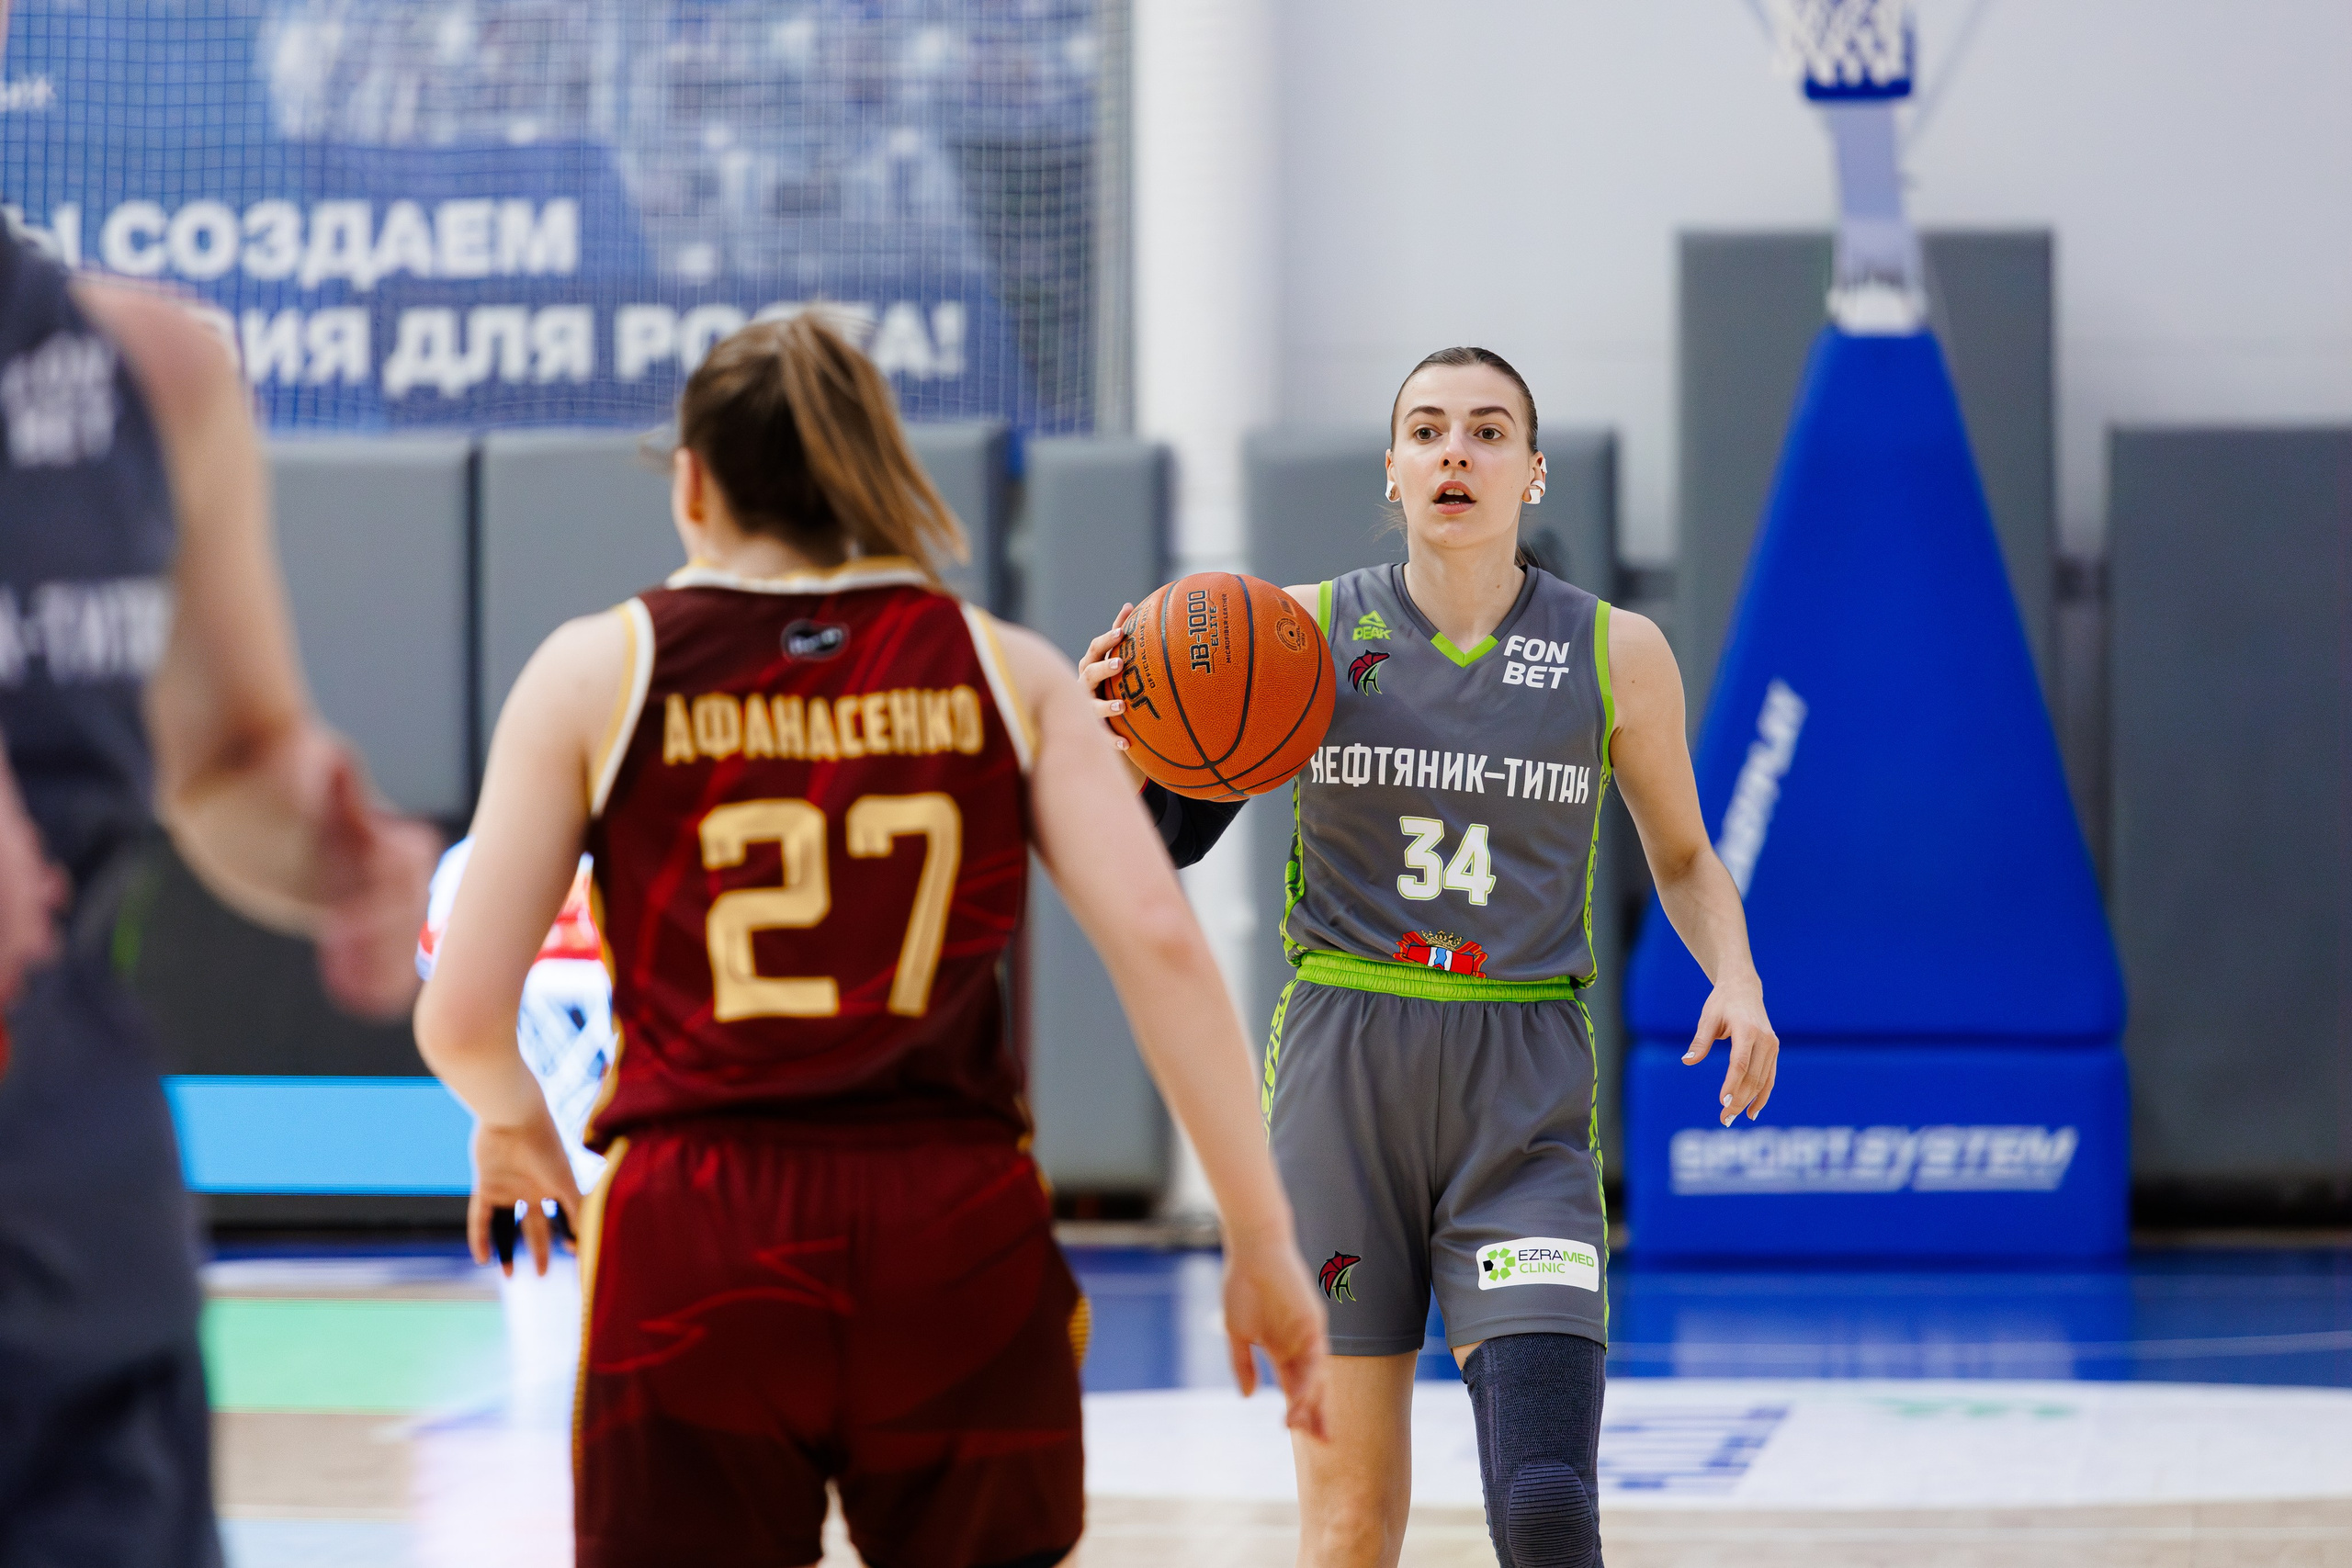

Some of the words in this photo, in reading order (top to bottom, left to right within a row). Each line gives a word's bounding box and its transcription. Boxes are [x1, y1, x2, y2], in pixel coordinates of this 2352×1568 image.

[99, 198, 579, 291] СОЗДАЕМ
[381, 304, 595, 398] ДЛЯ
[1187, 590, 1211, 674] JB-1000
[1209, 605, 1219, 647] ELITE
[1224, 621, 1232, 663] MICROFIBER
[1352, 626, 1393, 641] PEAK
[1141, 649, 1156, 689] OFFICIAL
[1503, 635, 1570, 664] FON
[1502, 660, 1569, 690] BET
[662, 684, 984, 765] АФАНАСЕНКО
[1396, 816, 1498, 906] 34
[698, 792, 963, 1022] 27
[1518, 1248, 1595, 1268] EZRAMED
[1520, 1262, 1566, 1274] CLINIC
